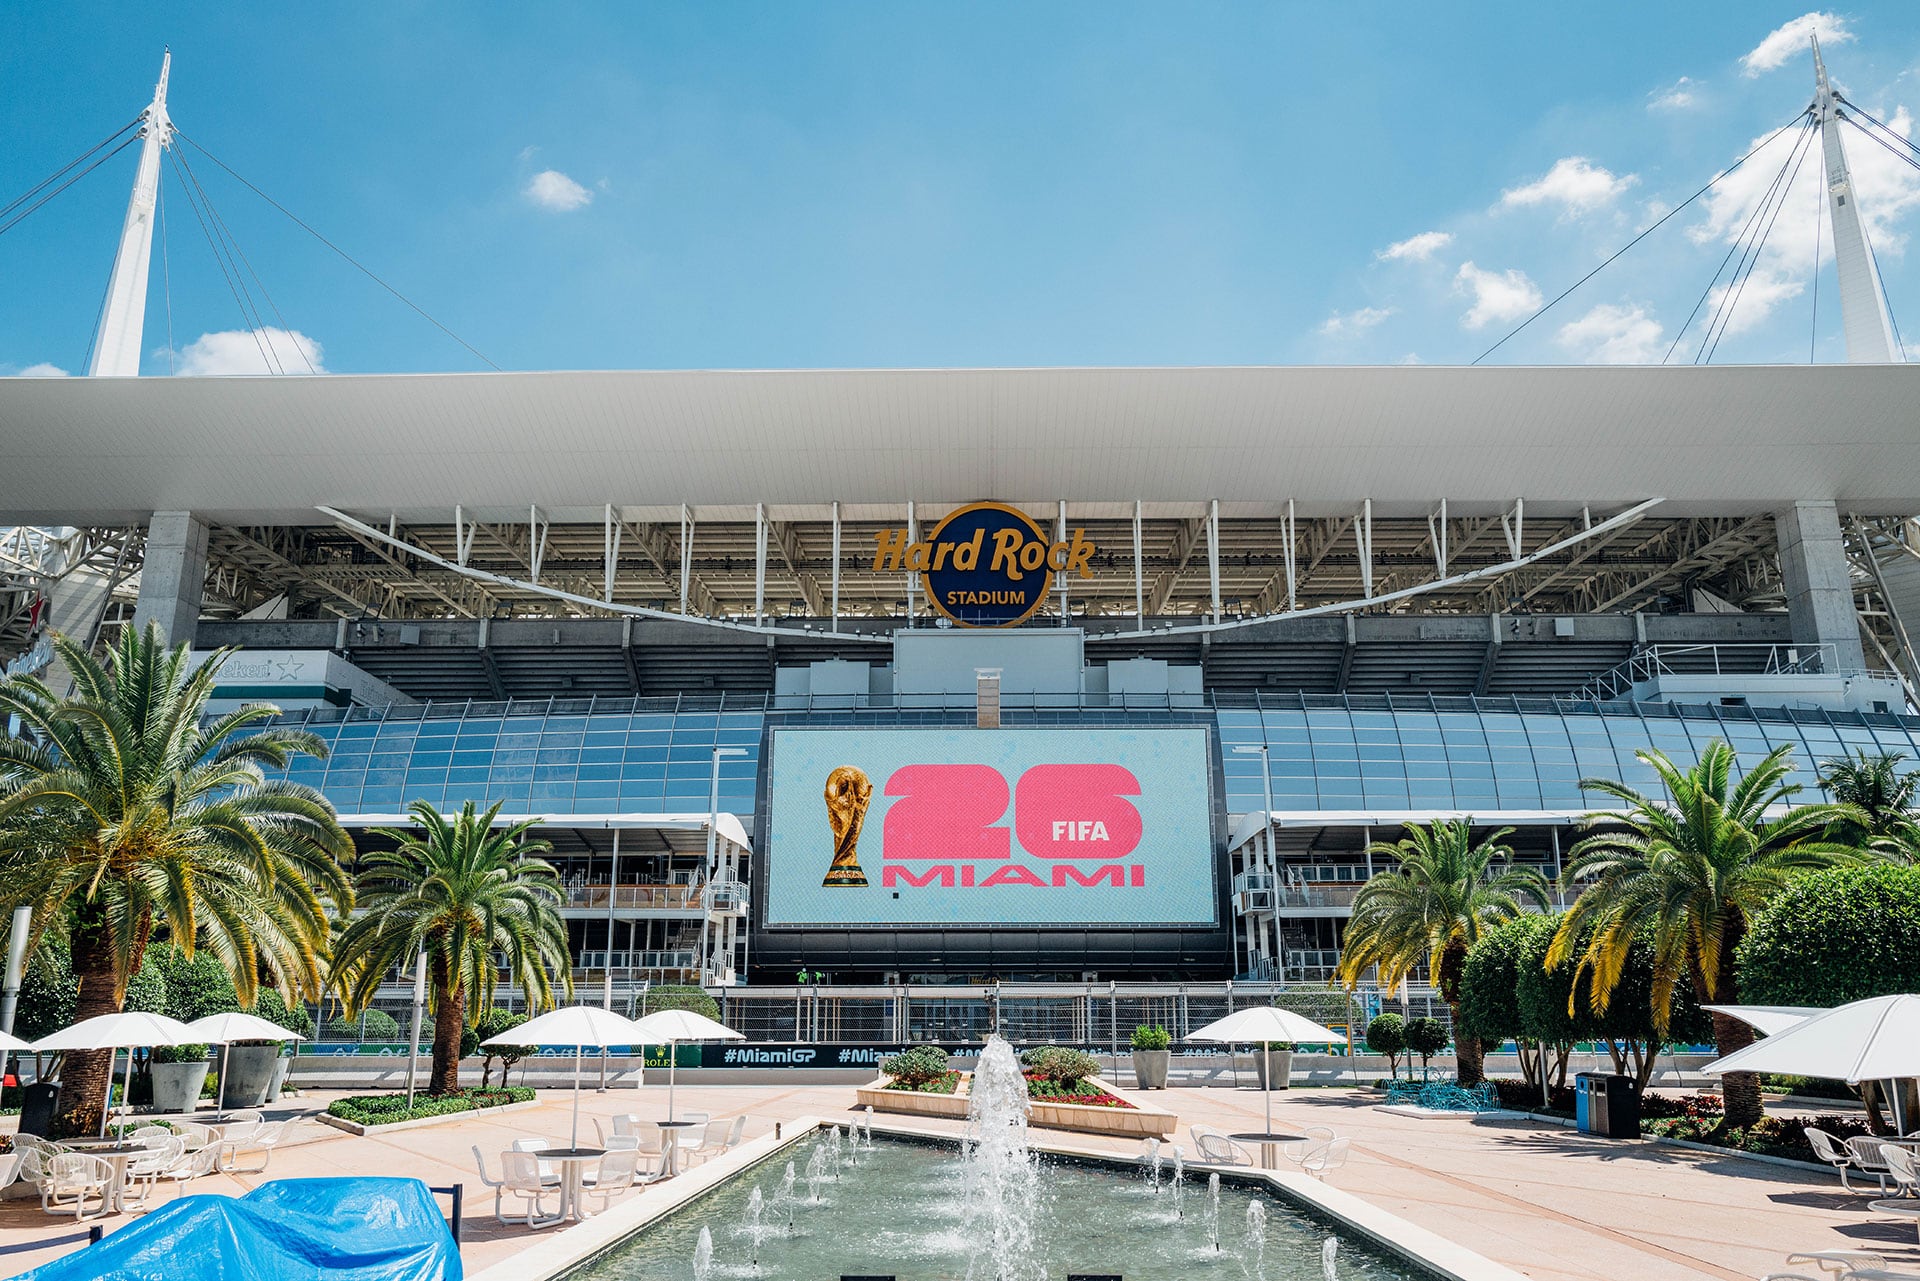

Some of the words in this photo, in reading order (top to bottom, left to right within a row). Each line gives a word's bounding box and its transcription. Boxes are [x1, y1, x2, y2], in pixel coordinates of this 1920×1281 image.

[871, 528, 986, 571] Hard
[990, 528, 1096, 581] Rock
[947, 591, 1025, 605] STADIUM
[883, 763, 1143, 860] 26
[1052, 820, 1110, 841] FIFA
[882, 864, 1145, 888] MIAMI
[724, 1048, 816, 1063] #MiamiGP
